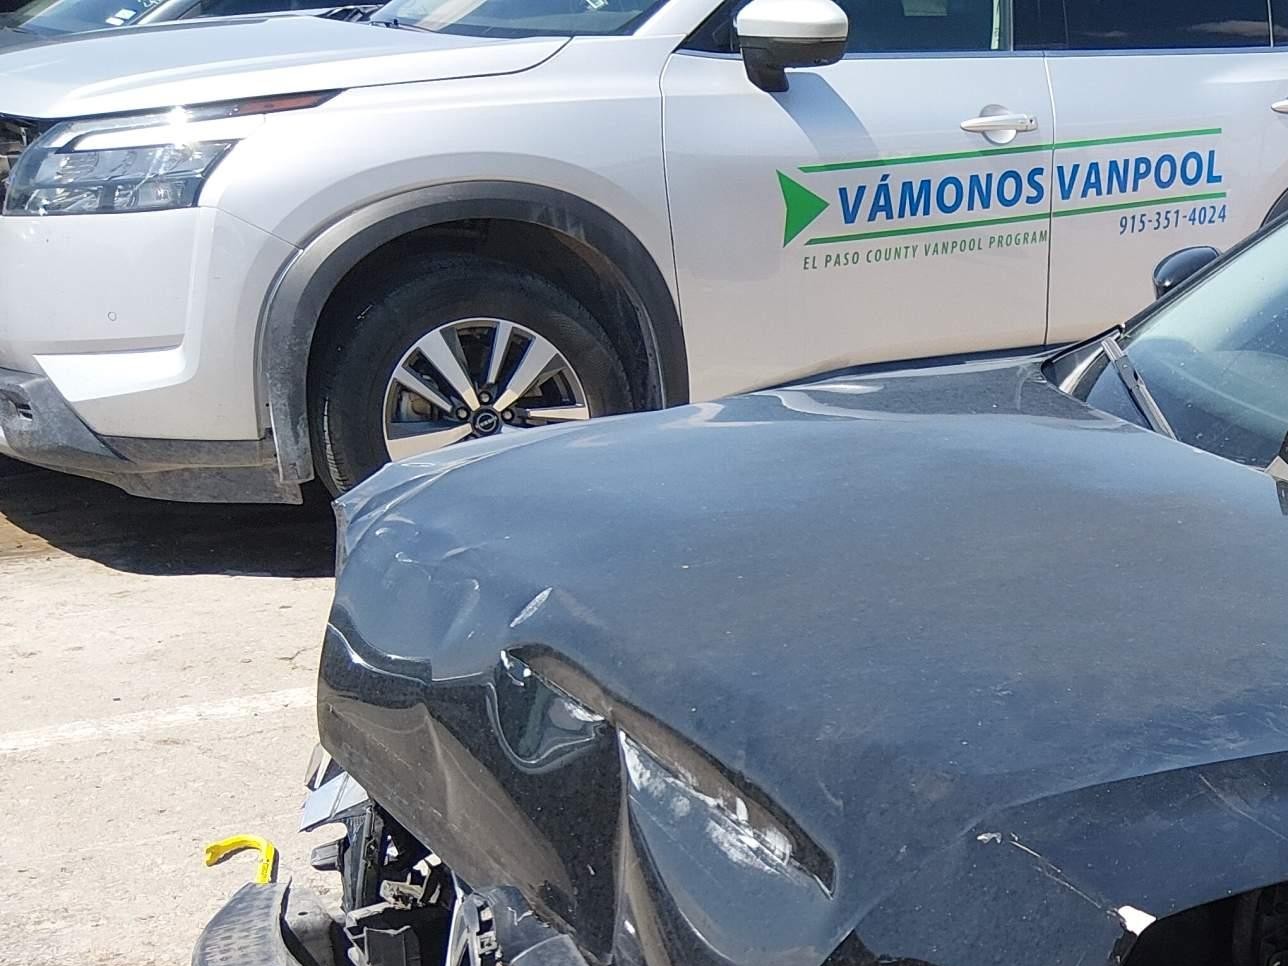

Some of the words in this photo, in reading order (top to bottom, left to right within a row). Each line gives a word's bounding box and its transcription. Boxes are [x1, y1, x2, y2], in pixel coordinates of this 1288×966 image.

[838, 167, 1045, 225] VÁMONOS
[1057, 150, 1222, 201] VANPOOL
[1119, 204, 1227, 236] 915-351-4024
[803, 256, 818, 270] EL
[824, 251, 860, 268] PASO
[866, 245, 919, 264] COUNTY
[924, 238, 983, 257] VANPOOL
[989, 229, 1048, 250] PROGRAM
